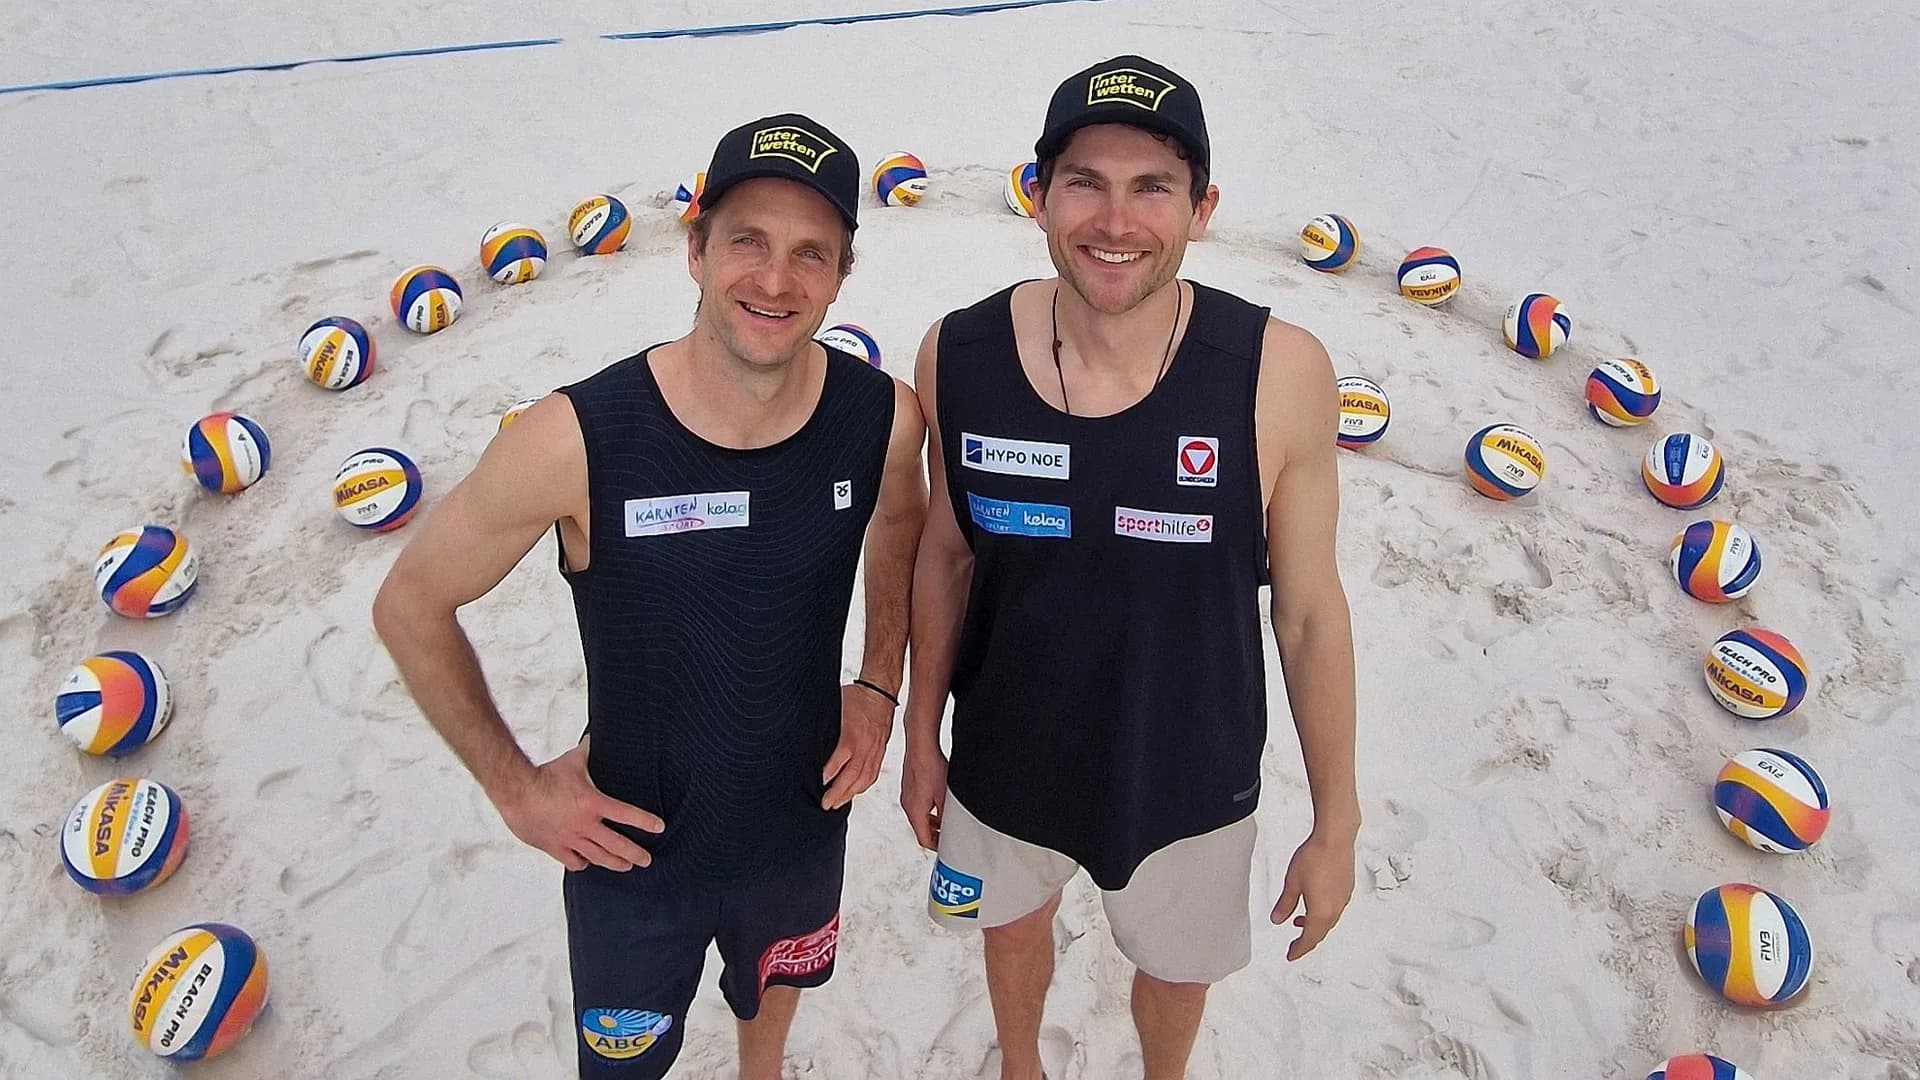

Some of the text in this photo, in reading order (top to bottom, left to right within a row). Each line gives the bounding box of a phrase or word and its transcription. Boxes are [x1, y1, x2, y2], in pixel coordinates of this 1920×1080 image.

[1095, 75, 1137, 90] inter
[1096, 84, 1155, 99] wetten
[759, 129, 800, 144] inter
[760, 140, 817, 159] wetten
[985, 448, 1063, 468] HYPO NOE
[1496, 438, 1542, 473] MIKASA
[336, 476, 390, 505] MIKASA
[707, 501, 747, 517] kelag
[1023, 510, 1066, 530] kelag
[1117, 515, 1197, 536] sporthilfe
[1718, 645, 1753, 667] BEACH
[1752, 665, 1777, 683] PRO
[1707, 662, 1765, 705] MIKASA
[142, 785, 158, 826] BEACH
[94, 782, 132, 857] MIKASA
[130, 826, 150, 858] PRO
[133, 945, 189, 1032] MIKASA
[160, 963, 213, 1048] BEACH PRO
[594, 1035, 647, 1050] ABC
